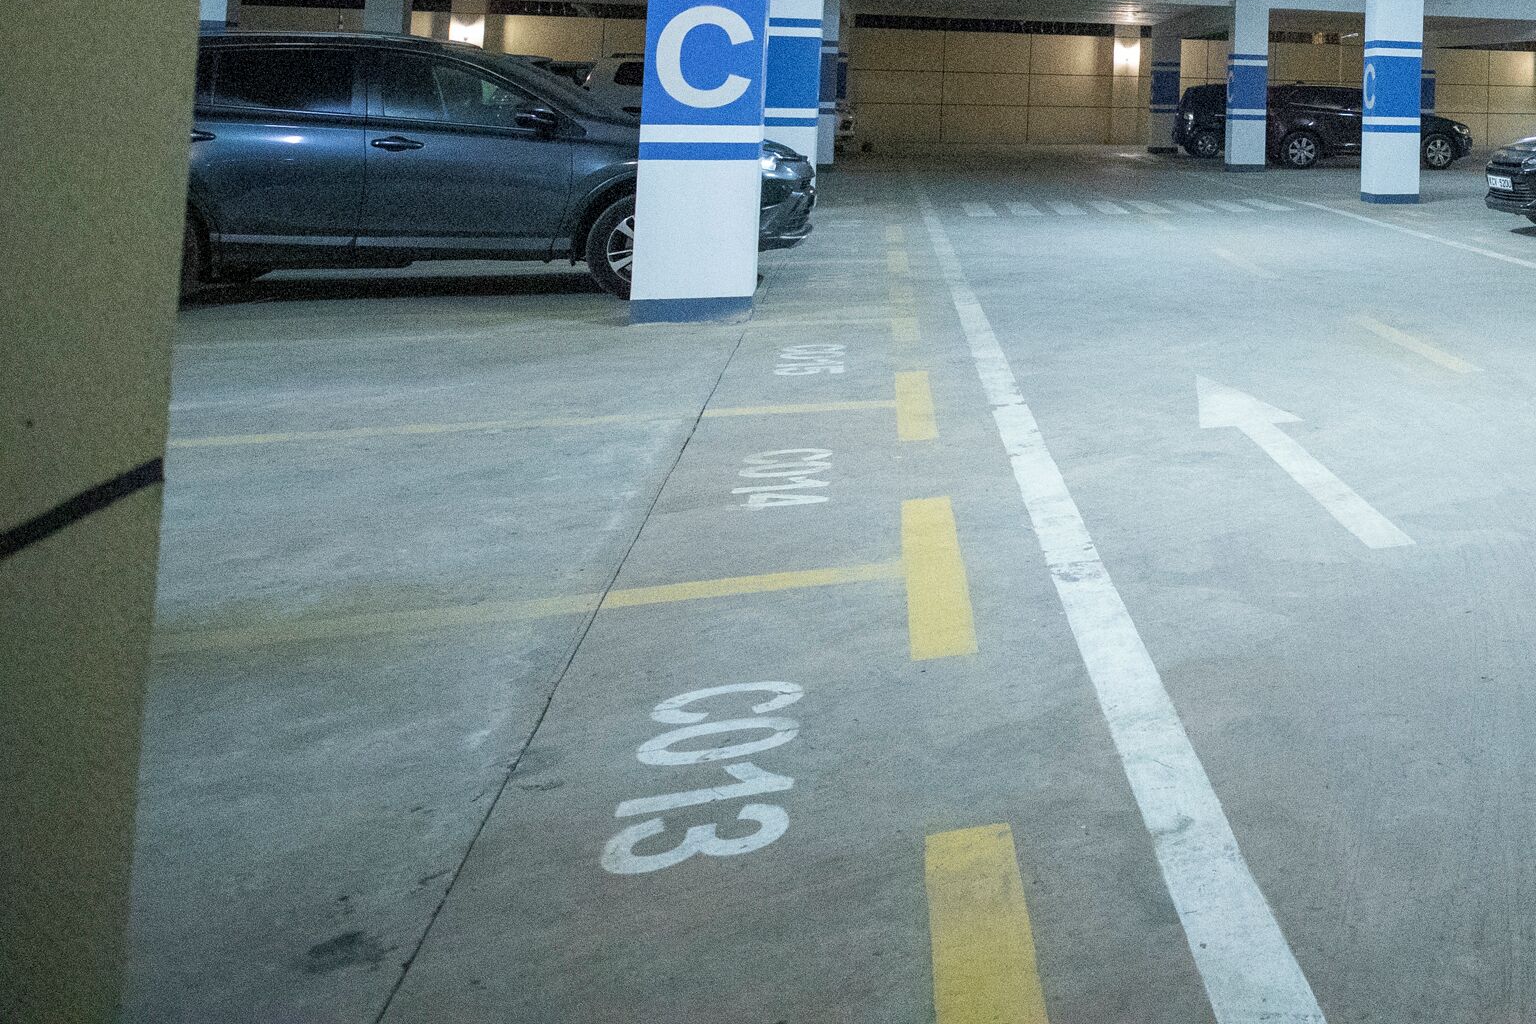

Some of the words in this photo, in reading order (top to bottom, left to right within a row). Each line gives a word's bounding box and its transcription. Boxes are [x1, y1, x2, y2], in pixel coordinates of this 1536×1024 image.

[656, 4, 755, 109] C
[1364, 63, 1376, 110] C
[773, 343, 847, 376] C015
[731, 447, 833, 511] C014
[600, 680, 804, 875] C013
